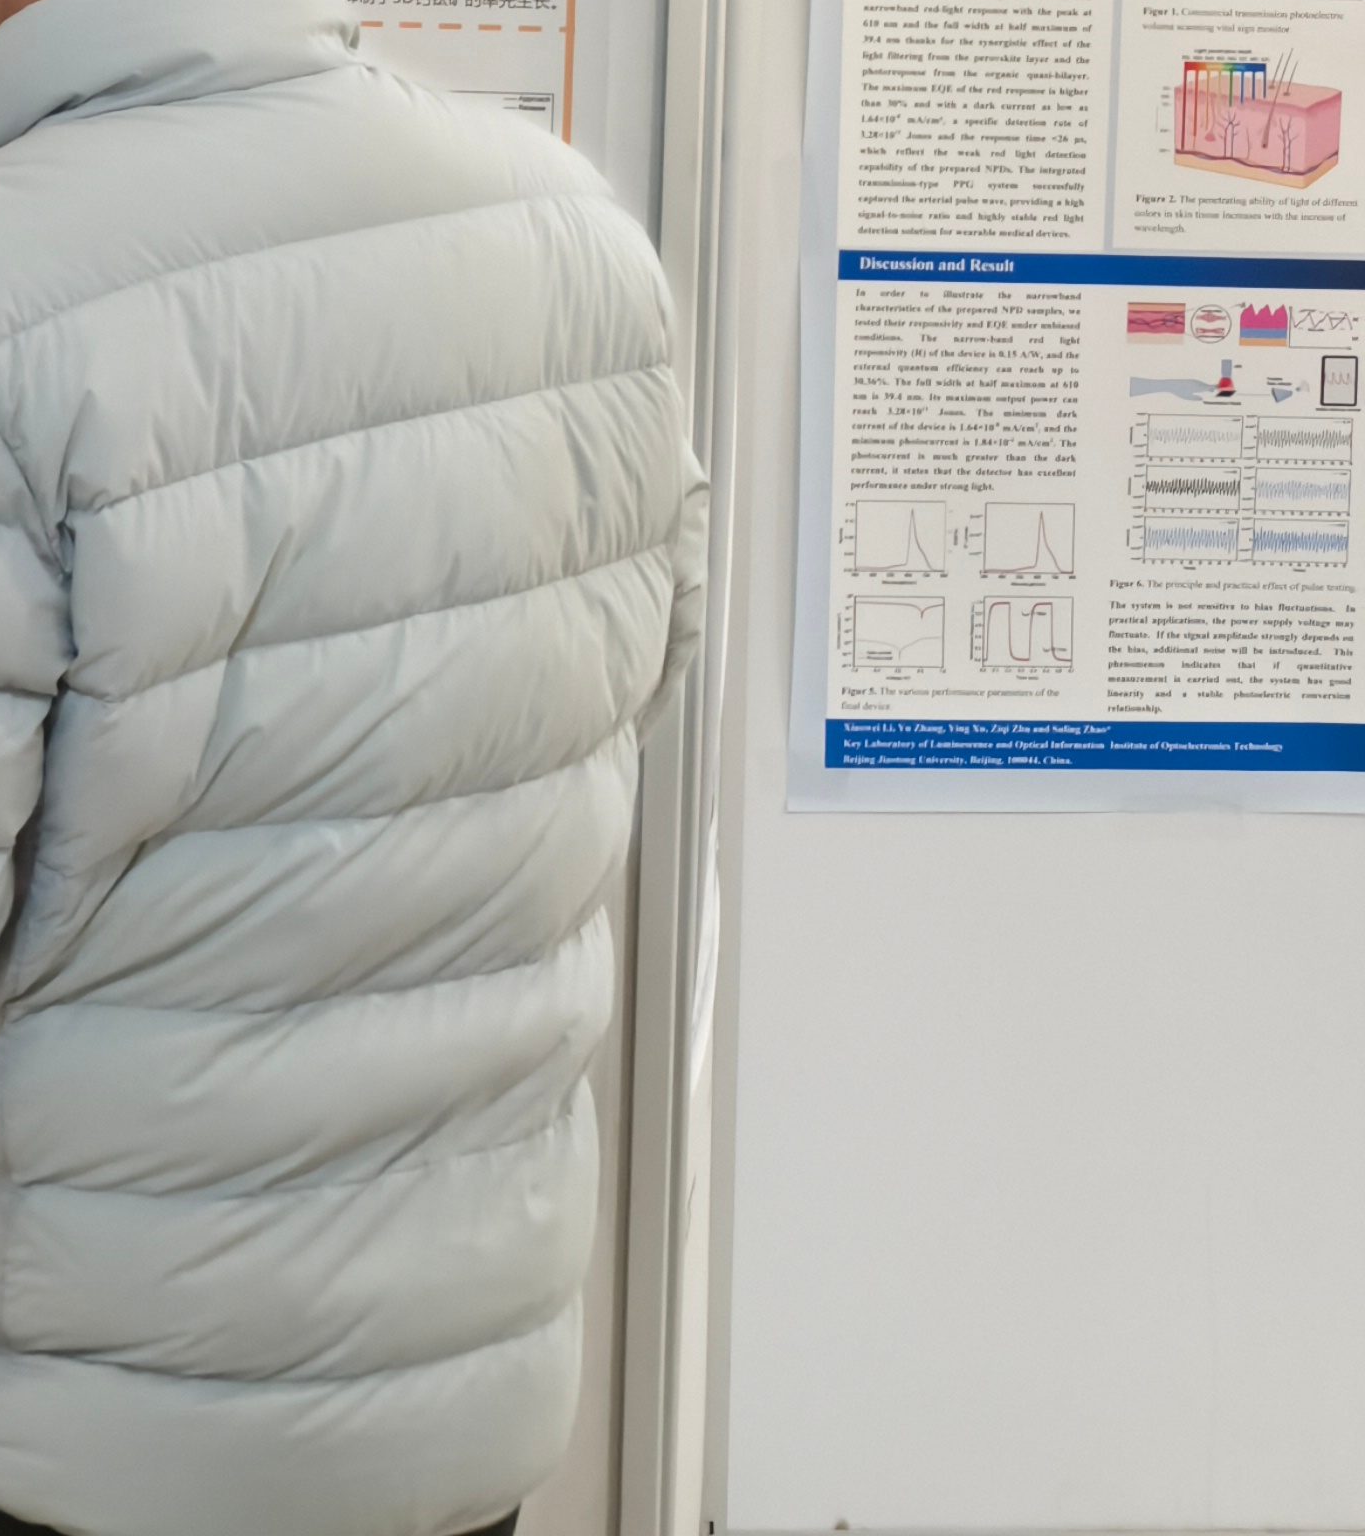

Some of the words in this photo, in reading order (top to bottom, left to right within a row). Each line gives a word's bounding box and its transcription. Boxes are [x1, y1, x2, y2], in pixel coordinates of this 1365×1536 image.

[860, 257, 934, 271] Discussion
[939, 259, 965, 272] and
[970, 259, 1014, 273] Result
